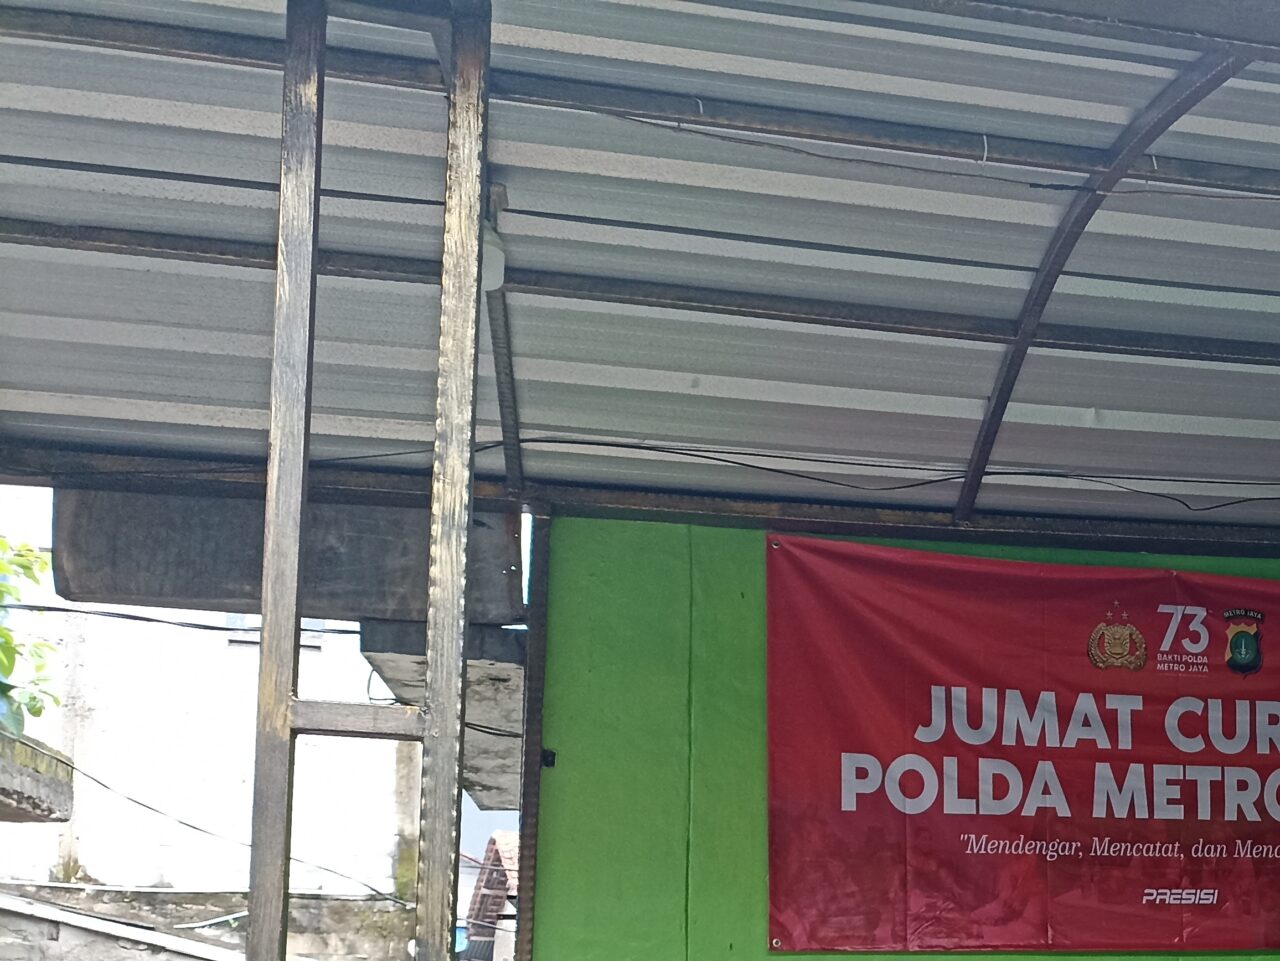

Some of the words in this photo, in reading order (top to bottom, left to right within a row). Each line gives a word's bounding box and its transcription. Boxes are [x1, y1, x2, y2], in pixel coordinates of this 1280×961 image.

[1247, 610, 1262, 619] JAYA
[1157, 604, 1210, 653] 73
[1157, 653, 1180, 662] BAKTI
[1183, 655, 1208, 663] POLDA
[1157, 663, 1186, 671] METRO
[914, 685, 1144, 749] JUMAT
[841, 752, 1071, 816] POLDA
[960, 834, 1083, 861] "Mendengar,
[1089, 837, 1184, 860] Mencatat,
[1191, 838, 1227, 858] dan
[1142, 889, 1219, 904] PRESISI
